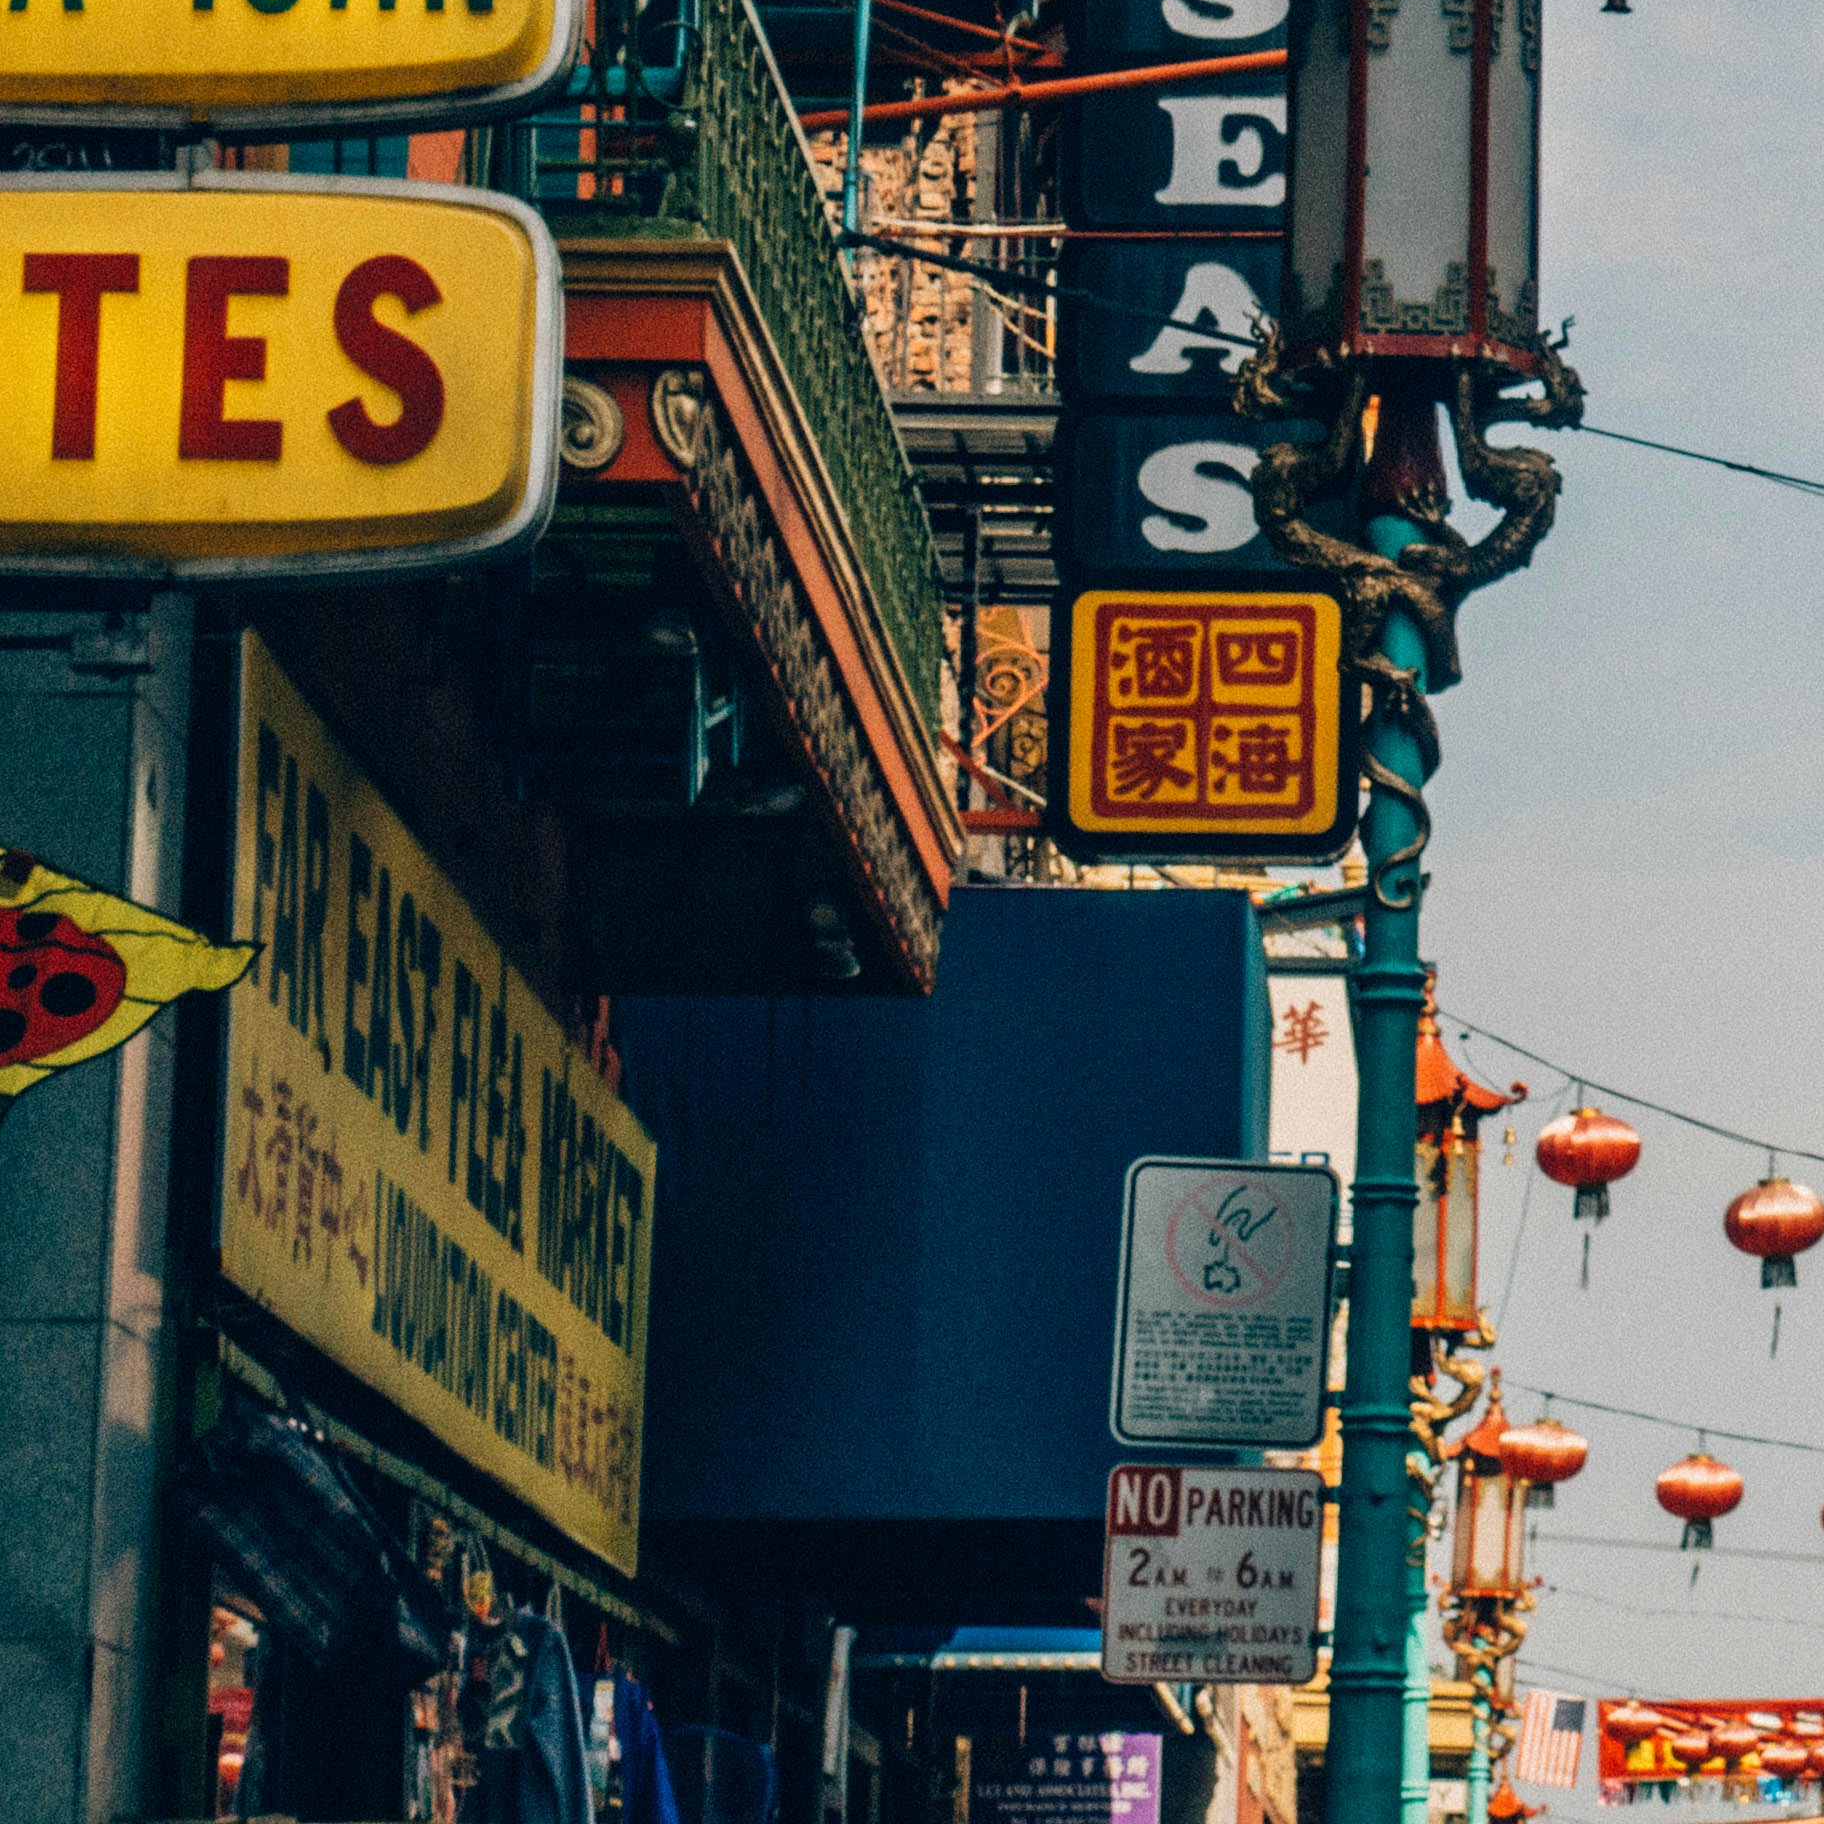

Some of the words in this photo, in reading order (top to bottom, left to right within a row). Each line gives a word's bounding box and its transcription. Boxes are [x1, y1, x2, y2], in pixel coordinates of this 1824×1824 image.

[22, 251, 446, 467] TES
[251, 721, 329, 1066] FAR
[344, 832, 442, 1154] EAST
[447, 956, 527, 1258] FLEA
[535, 1066, 643, 1356] MARKET
[494, 1287, 559, 1471] CENTER
[1116, 1473, 1174, 1527] NO
[1186, 1488, 1316, 1528] PARKING
[1118, 1622, 1217, 1643] INCLUDING
[1218, 1625, 1302, 1646] HOLIDAYS
[1126, 1651, 1193, 1674] STREET
[1203, 1653, 1295, 1676] CLEANING
